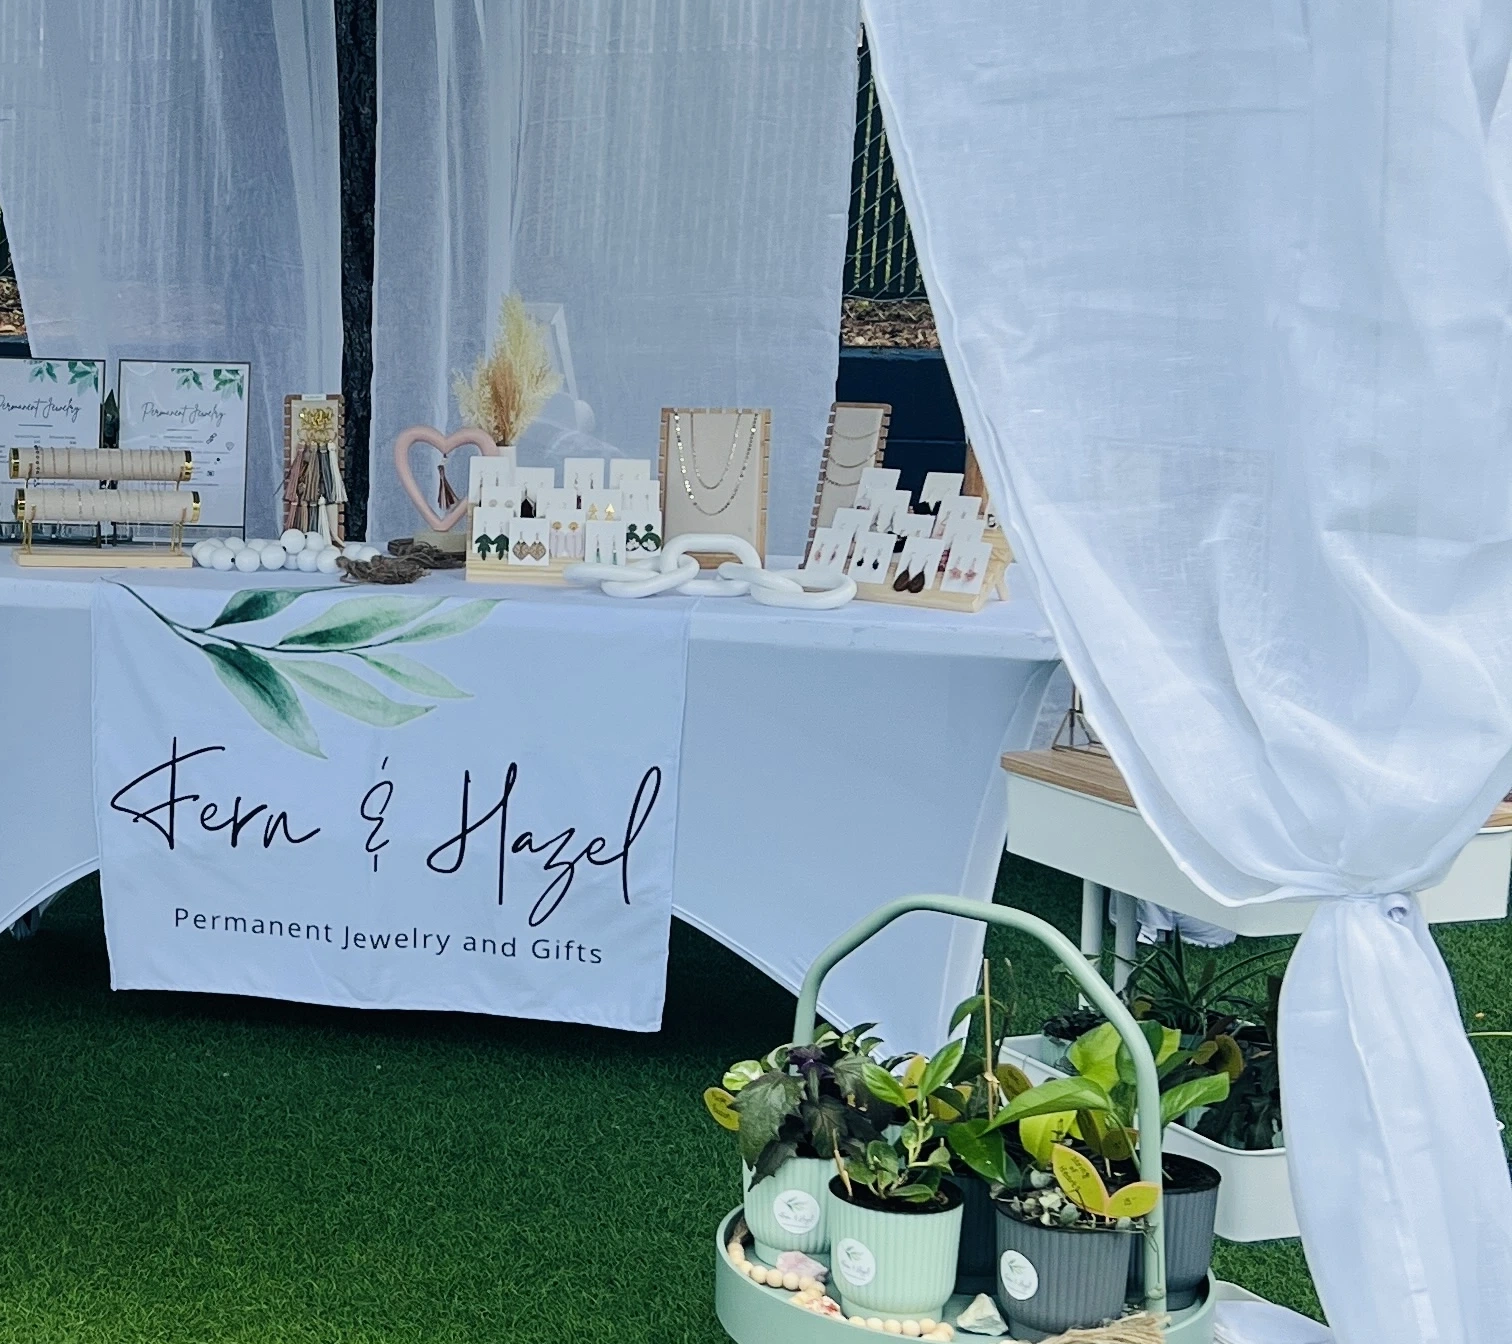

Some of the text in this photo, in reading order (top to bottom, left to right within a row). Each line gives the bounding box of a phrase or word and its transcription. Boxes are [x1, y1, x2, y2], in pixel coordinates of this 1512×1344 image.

[42, 397, 82, 423] Jewelry
[141, 401, 226, 427] Permanent Jewelry
[110, 736, 662, 927] Fern & Hazel
[173, 906, 604, 966] Permanent Jewelry and Gifts
